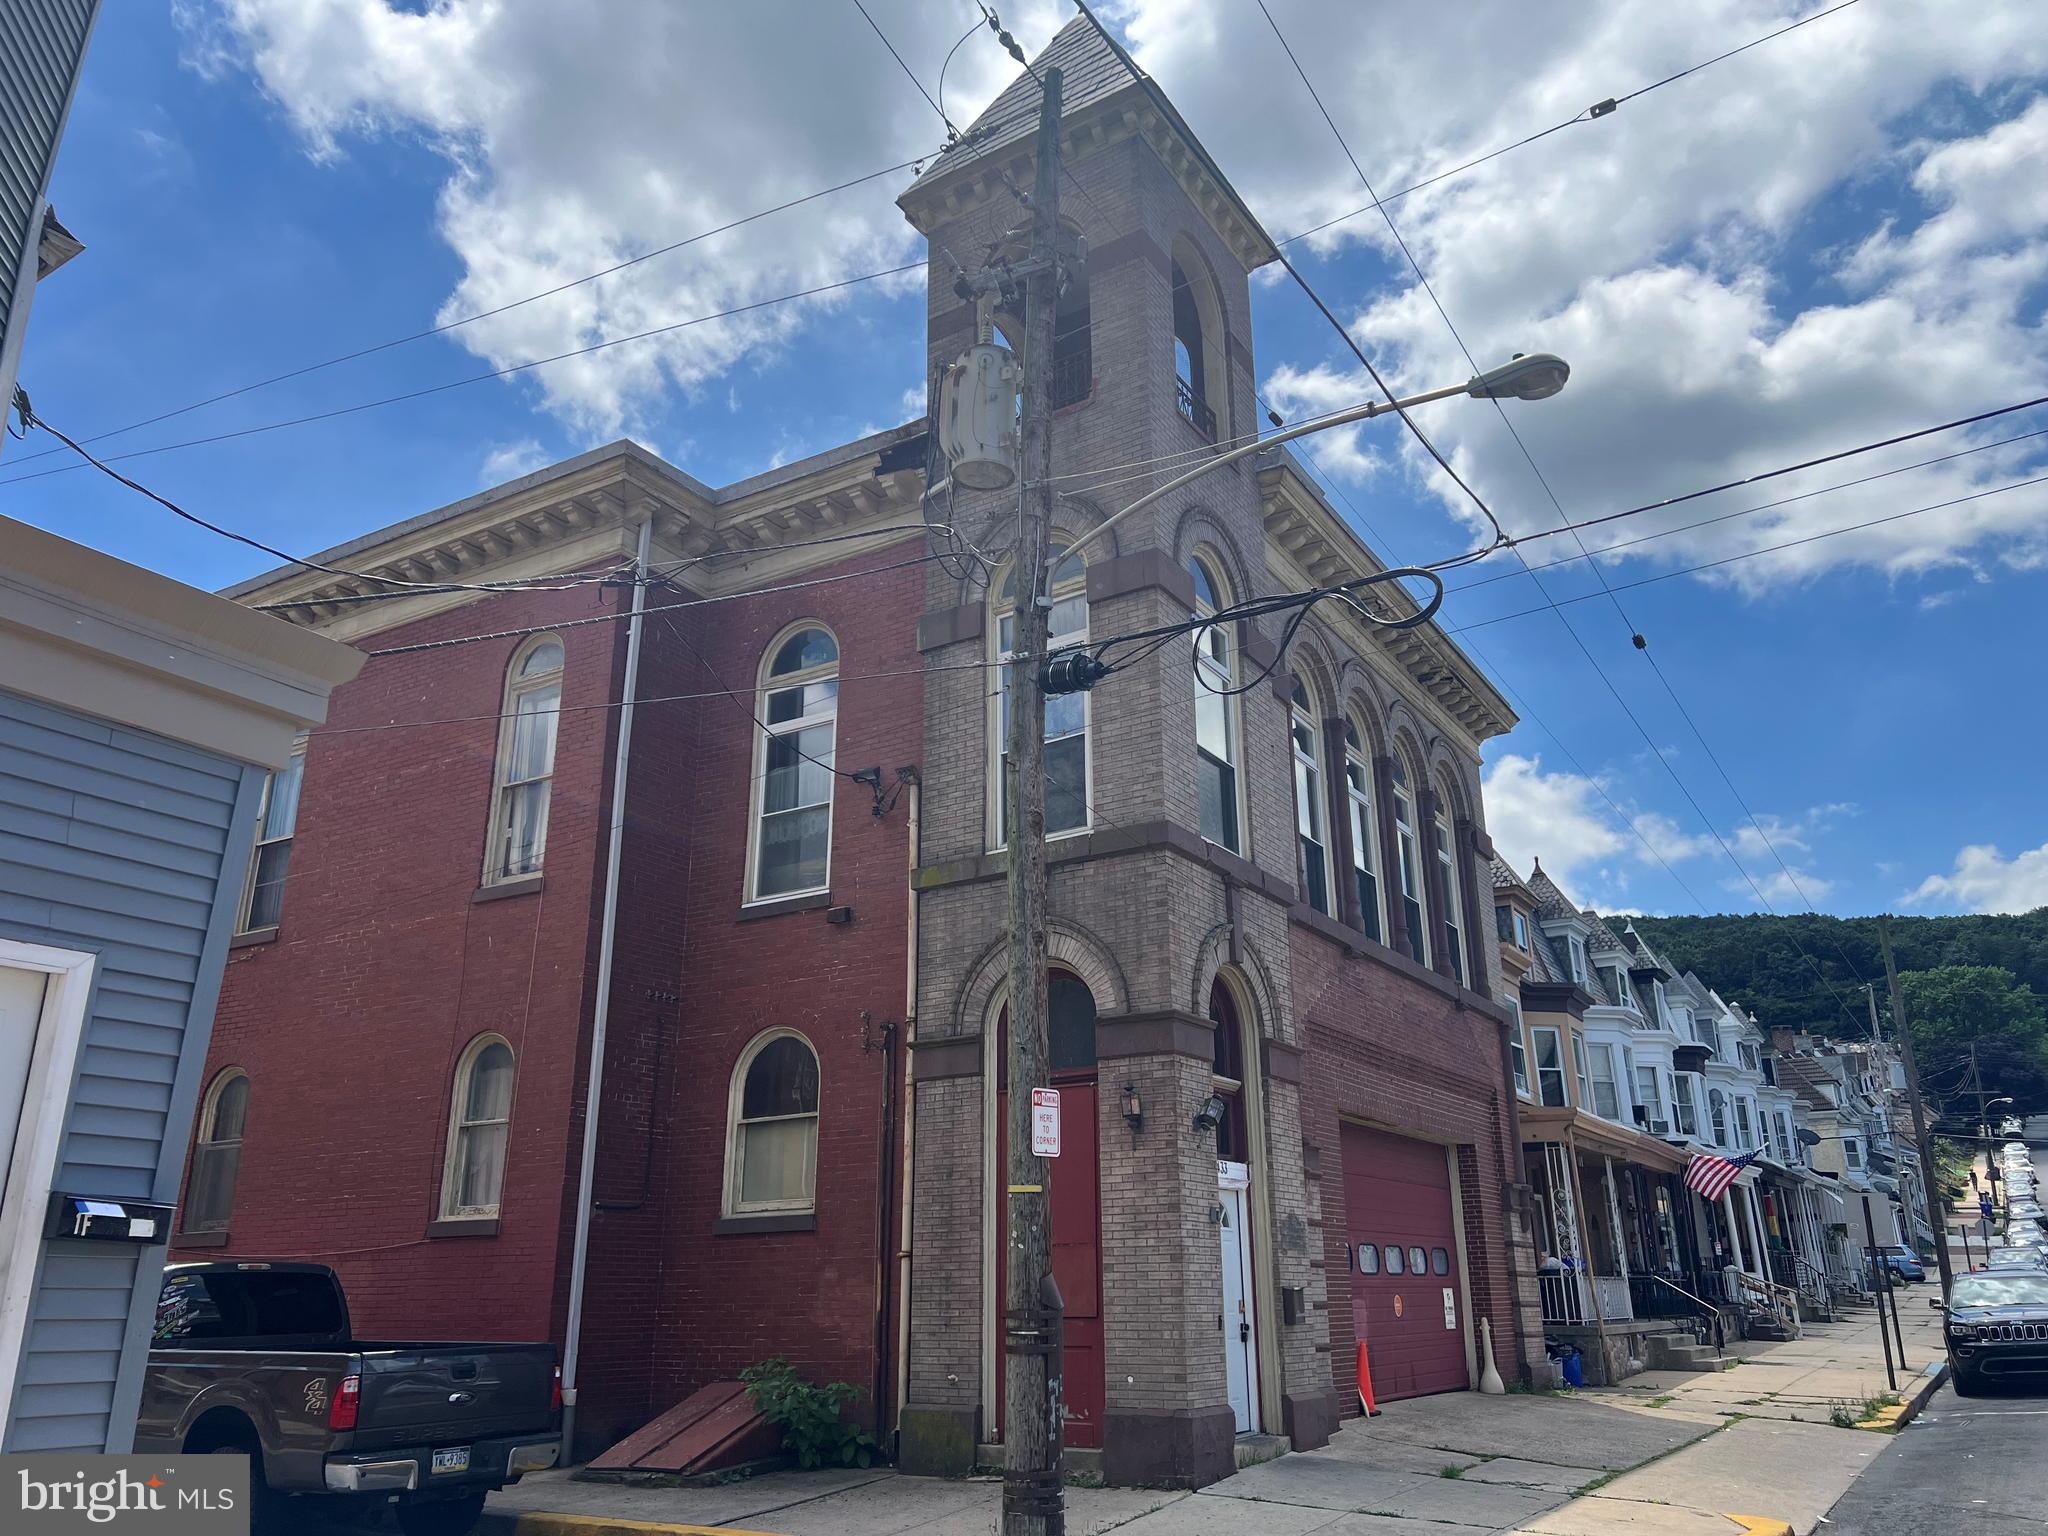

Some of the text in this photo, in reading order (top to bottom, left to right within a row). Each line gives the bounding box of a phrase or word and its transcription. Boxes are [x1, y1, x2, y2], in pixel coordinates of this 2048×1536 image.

[1034, 1092, 1057, 1105] NO PARKING
[1040, 1114, 1053, 1123] HERE
[1043, 1125, 1050, 1134] TO
[1036, 1136, 1056, 1145] CORNER
[73, 1212, 93, 1237] 1F
